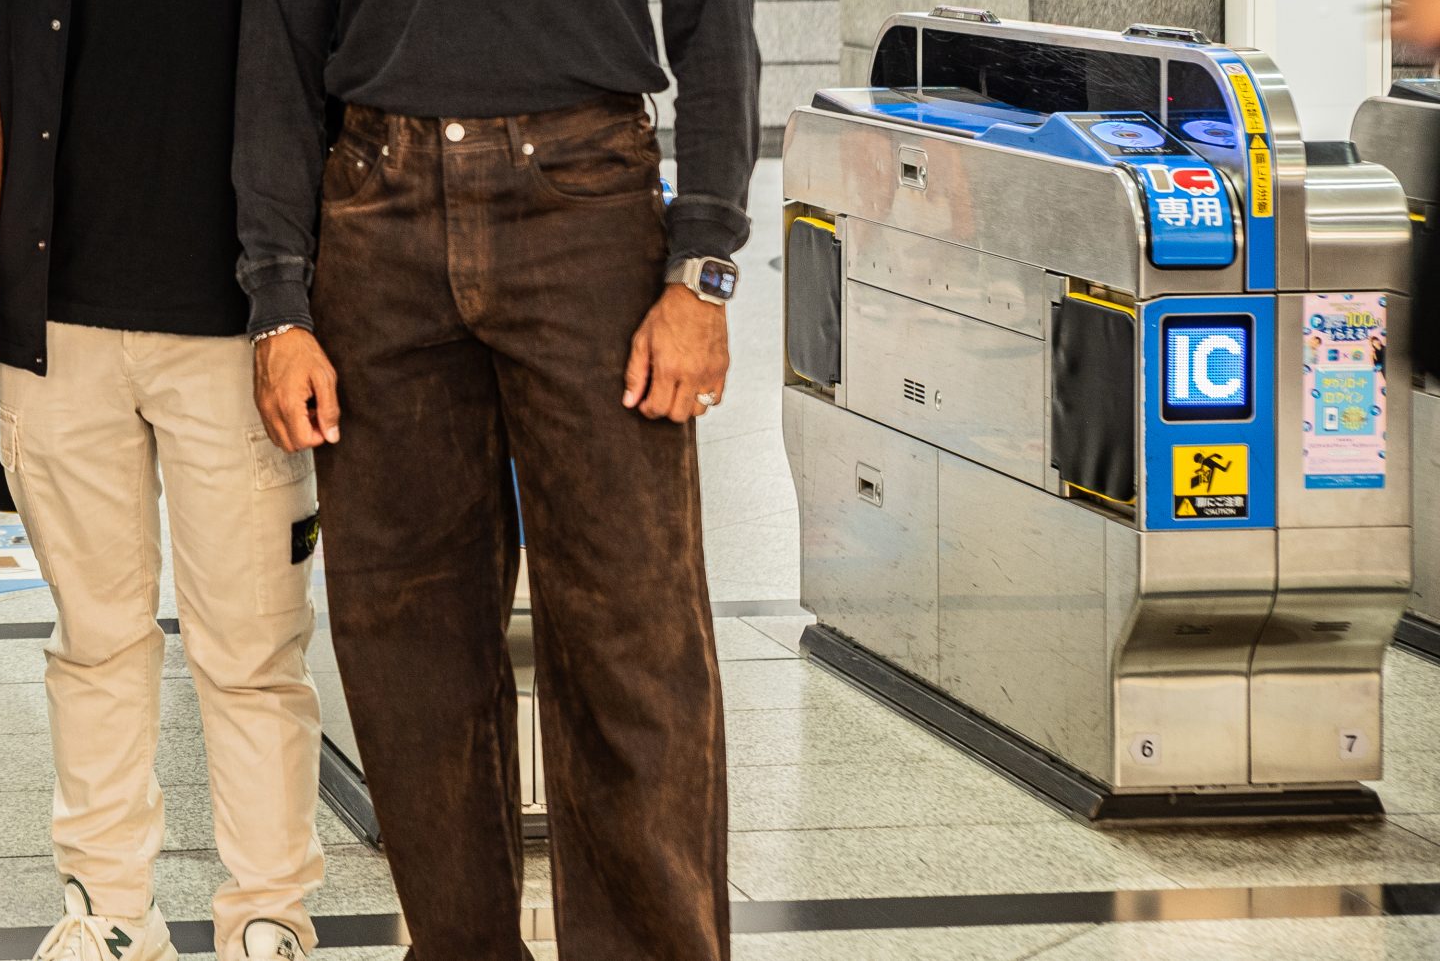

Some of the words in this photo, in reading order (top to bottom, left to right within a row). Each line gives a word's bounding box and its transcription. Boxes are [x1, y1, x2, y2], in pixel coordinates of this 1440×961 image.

[1154, 197, 1224, 227] 専用
[1175, 335, 1241, 398] IC
[1141, 739, 1154, 758] 6
[1343, 734, 1358, 753] 7
